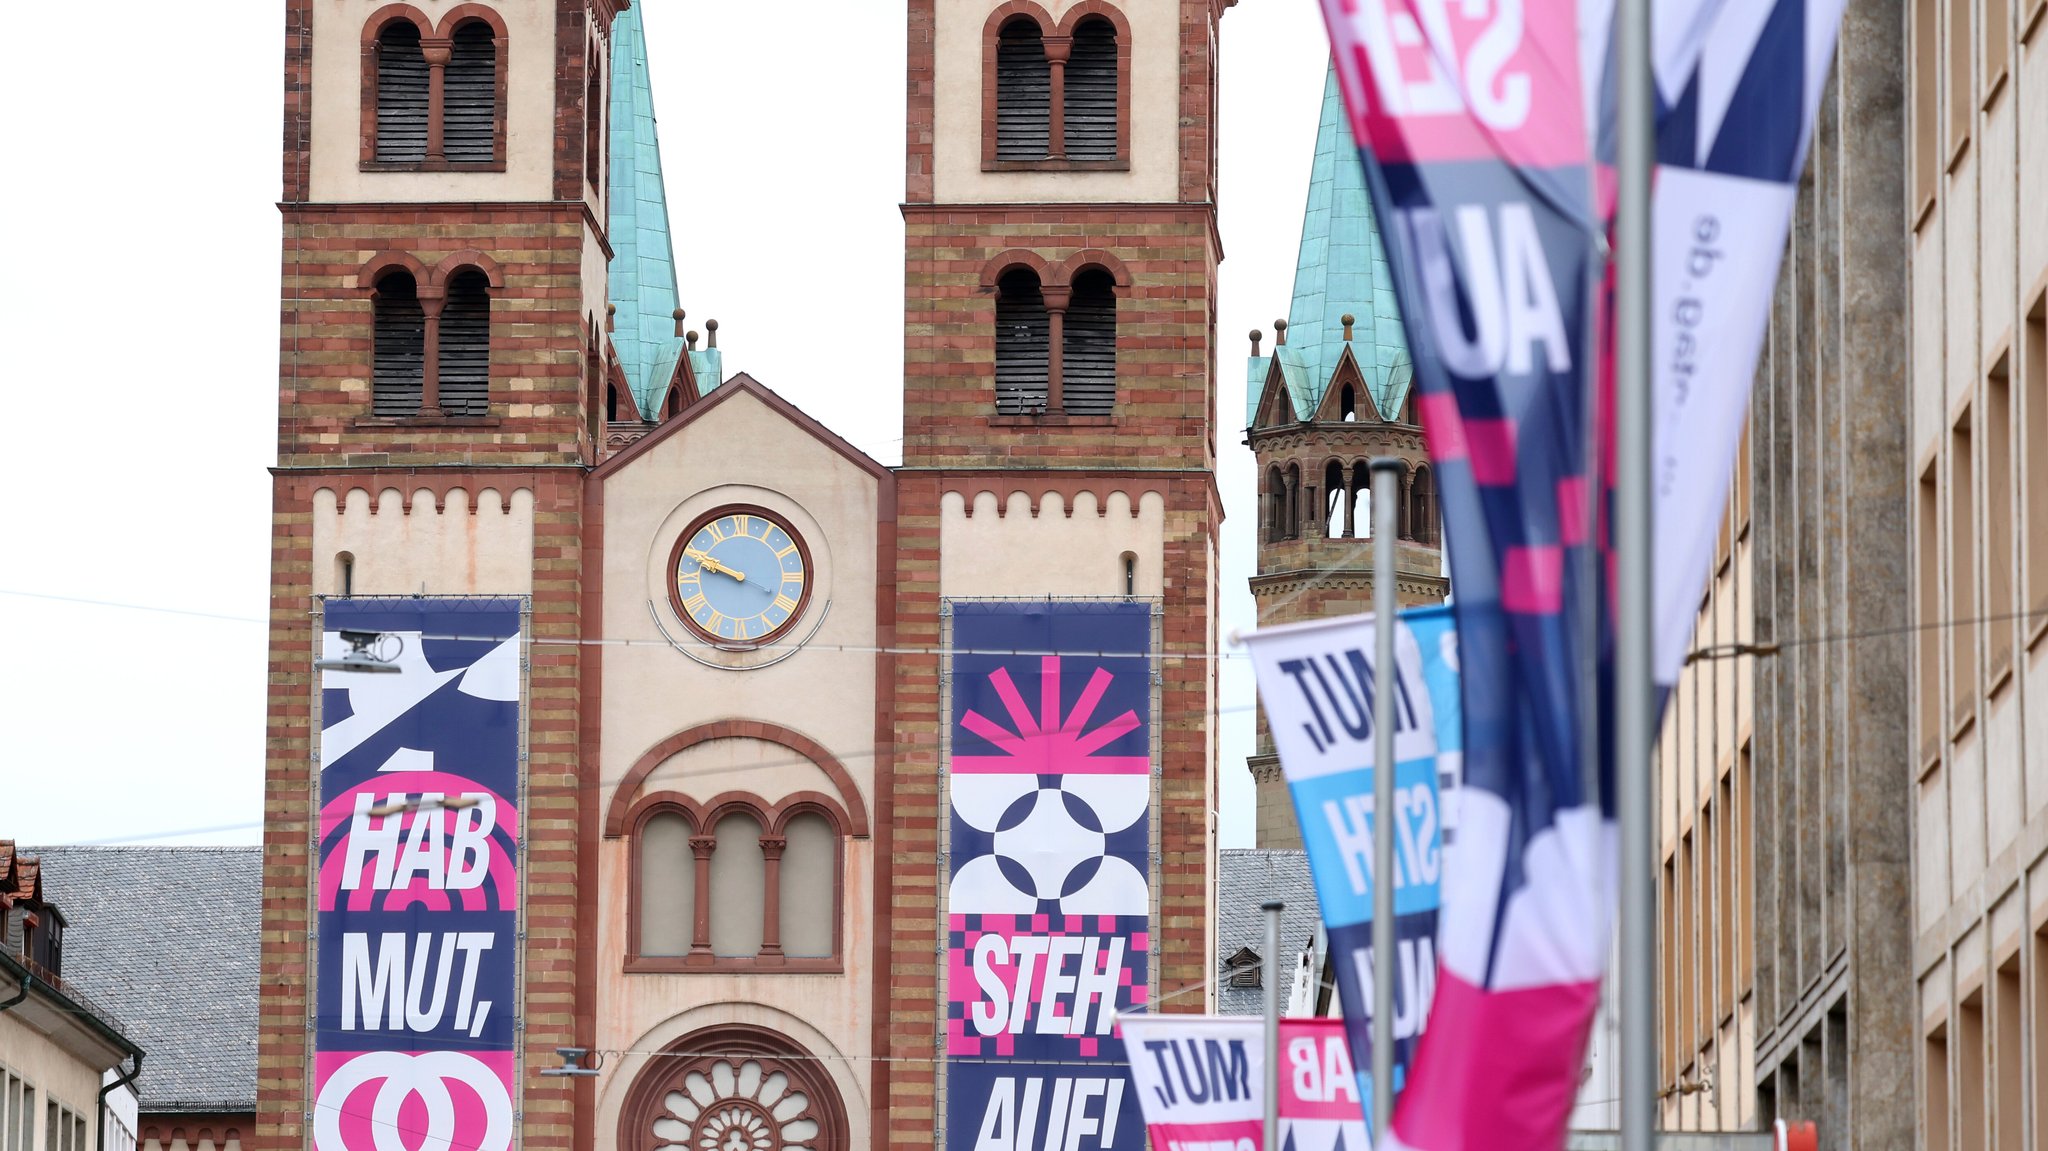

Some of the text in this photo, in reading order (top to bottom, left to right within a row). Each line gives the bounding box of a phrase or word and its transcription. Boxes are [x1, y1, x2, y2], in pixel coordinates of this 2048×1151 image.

[705, 522, 724, 541] XI
[733, 516, 748, 536] XII
[761, 522, 776, 541] I
[776, 544, 796, 559] II
[679, 571, 699, 584] IX
[783, 572, 802, 583] III
[686, 593, 706, 617] VIII
[774, 593, 797, 613] IIII
[704, 611, 723, 635] VII
[735, 618, 747, 640] VI
[761, 613, 777, 632] V
[341, 792, 496, 890] HAB
[341, 932, 495, 1038] MUT,
[971, 933, 1126, 1036] STEH
